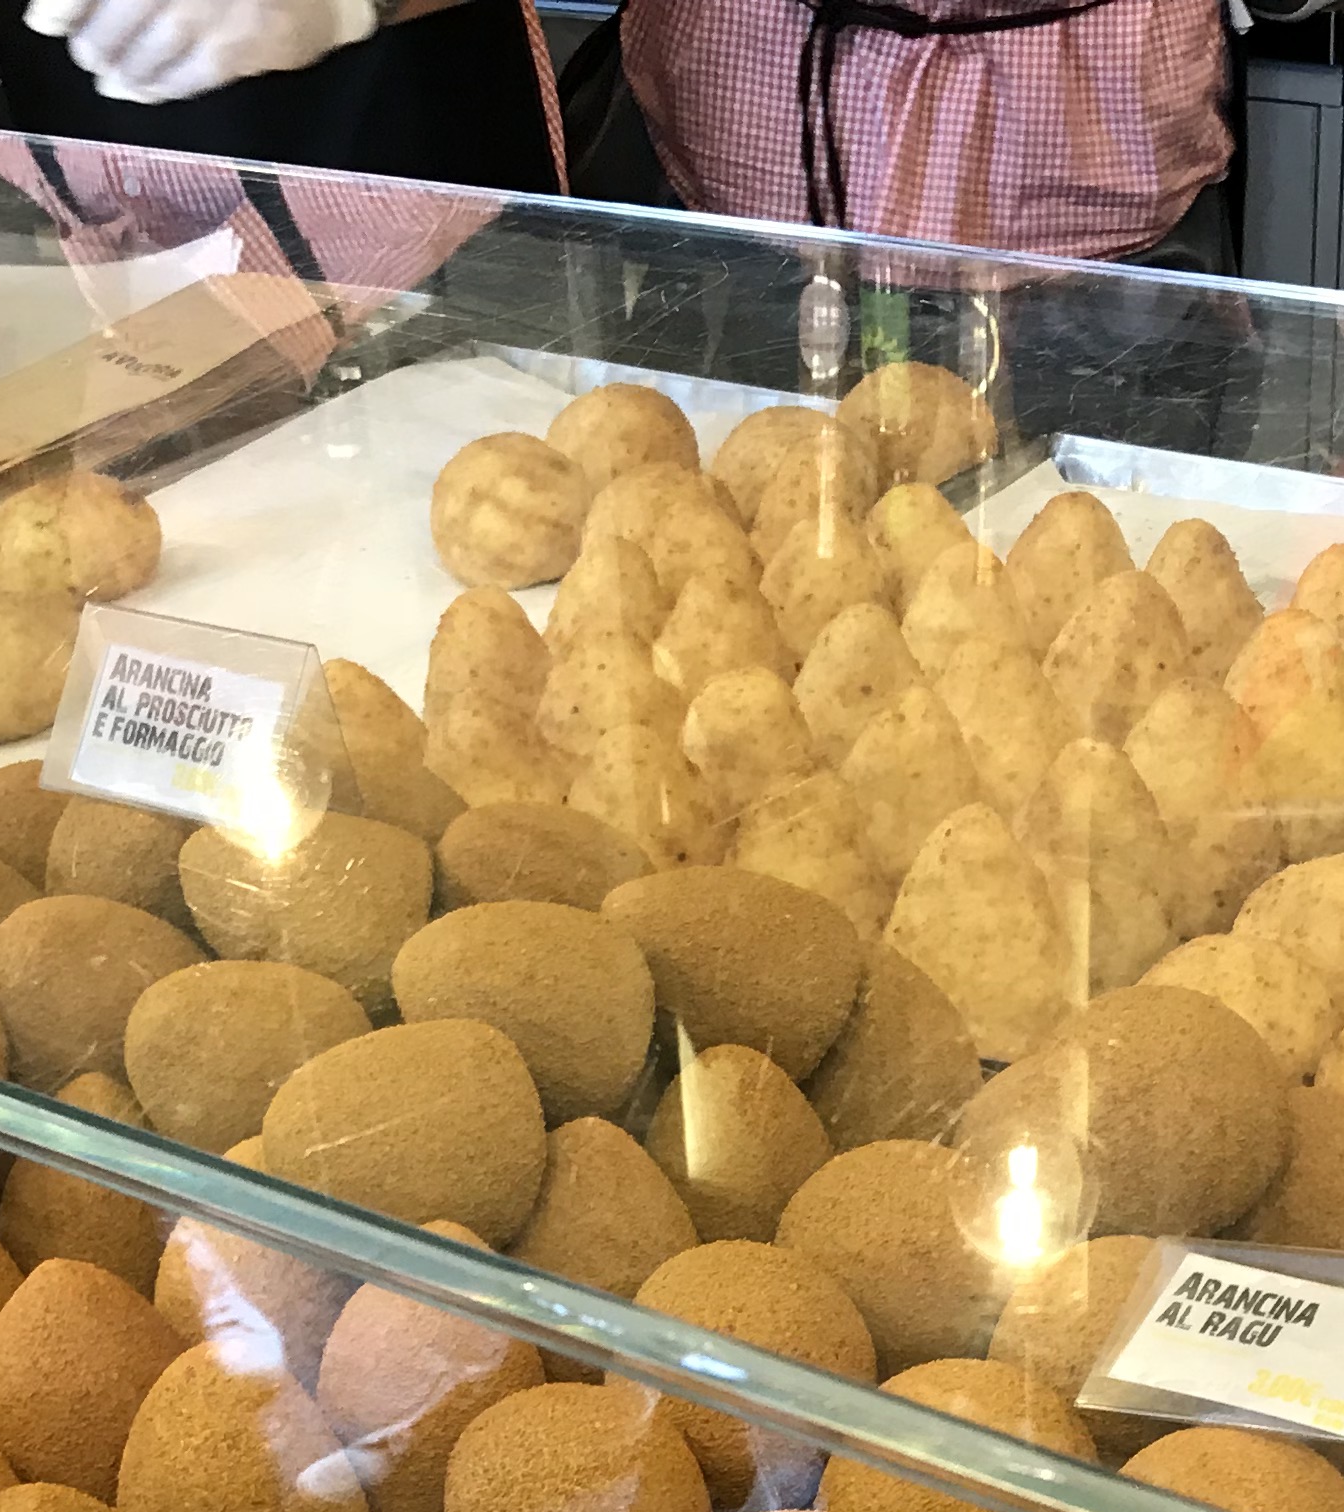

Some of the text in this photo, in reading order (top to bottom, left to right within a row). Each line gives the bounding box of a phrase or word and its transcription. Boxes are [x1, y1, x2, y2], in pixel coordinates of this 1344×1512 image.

[101, 684, 127, 713] AL
[109, 653, 214, 702] ARANCINA
[92, 711, 227, 767] E FORMAGGIO
[1173, 1271, 1321, 1328] ARANCINA
[1155, 1301, 1285, 1348] AL RAGU
